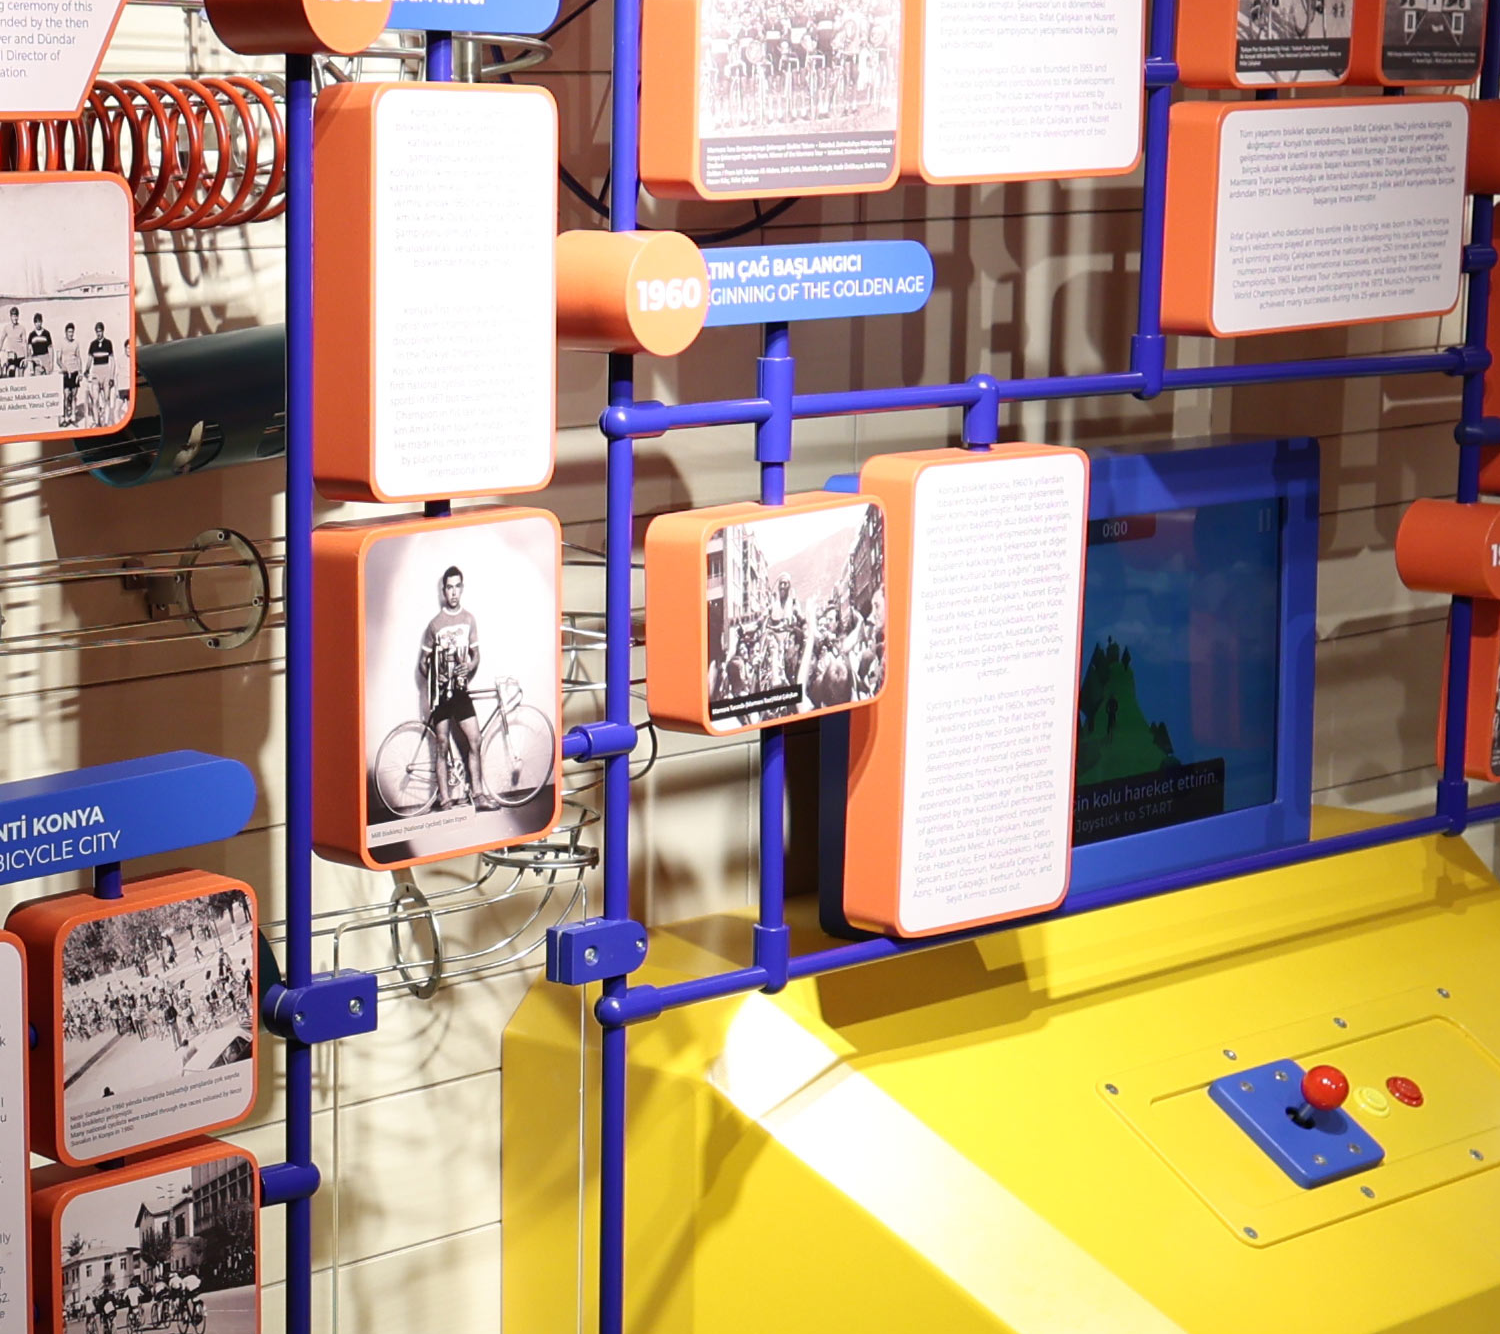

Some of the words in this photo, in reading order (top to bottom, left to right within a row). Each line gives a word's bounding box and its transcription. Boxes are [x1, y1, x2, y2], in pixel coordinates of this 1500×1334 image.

[707, 261, 735, 280] TIN
[738, 255, 770, 283] ÇAĞ
[773, 254, 862, 280] BAŞLANGICI
[636, 277, 700, 312] 1960
[708, 284, 776, 306] GINNING
[779, 283, 800, 302] OF
[802, 281, 831, 300] THE
[833, 277, 893, 298] GOLDEN
[896, 275, 925, 294] AGE
[1102, 520, 1128, 538] 0:00
[1093, 788, 1121, 809] kolu
[1124, 778, 1174, 802] hareket
[32, 805, 105, 836] KONYA
[1124, 810, 1136, 823] to
[1138, 800, 1173, 818] START
[78, 830, 122, 856] CITY
